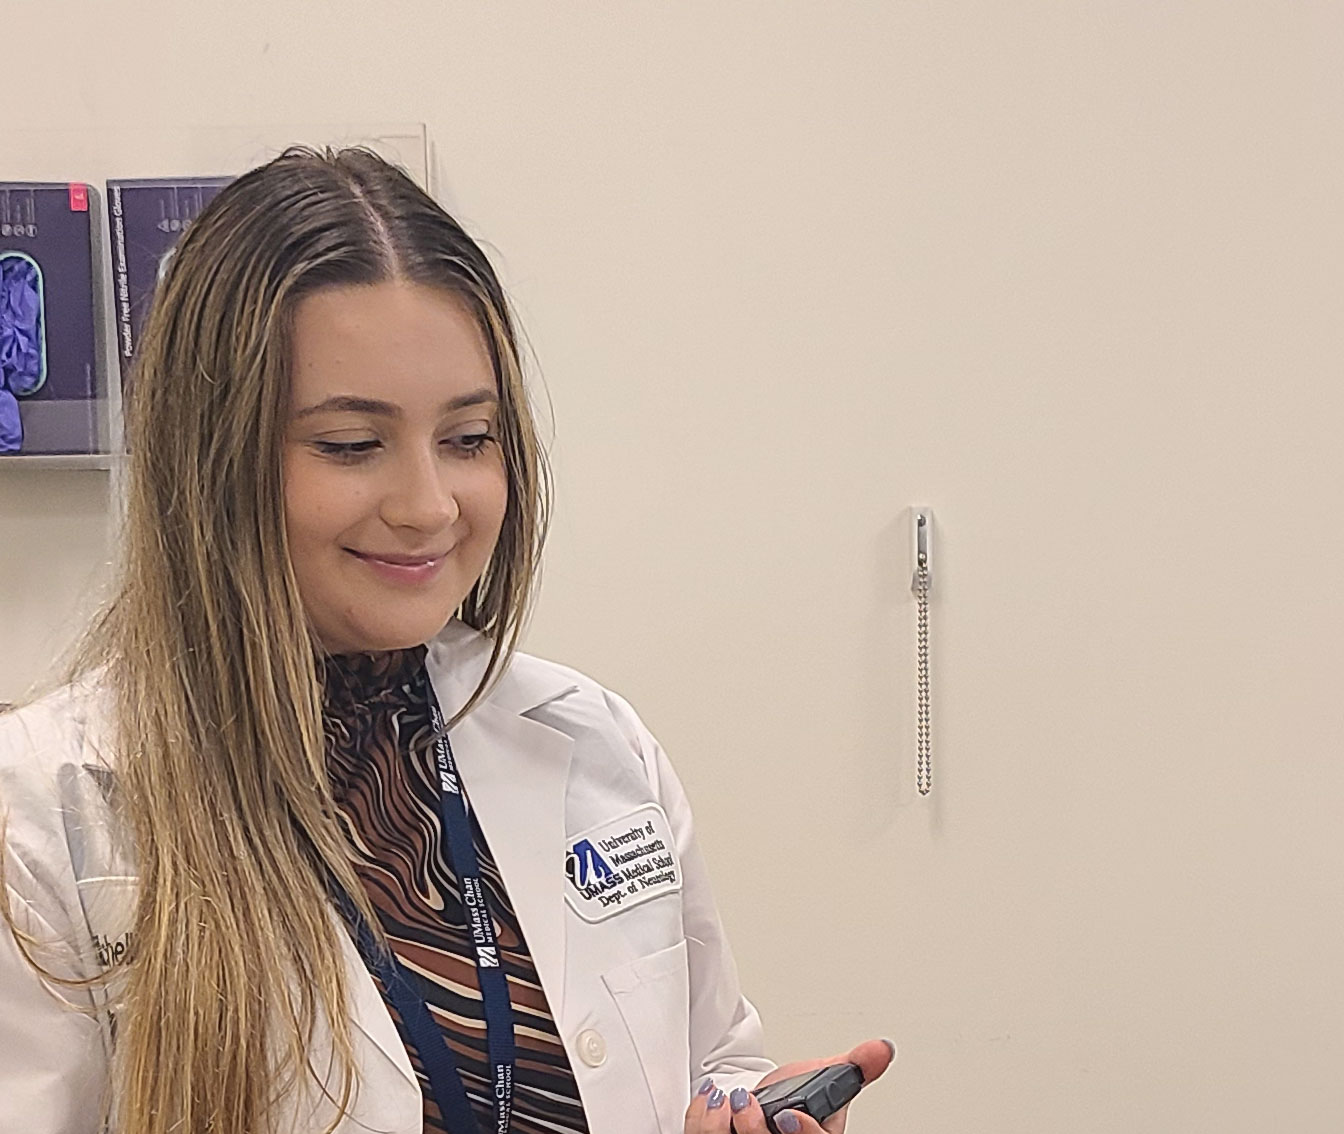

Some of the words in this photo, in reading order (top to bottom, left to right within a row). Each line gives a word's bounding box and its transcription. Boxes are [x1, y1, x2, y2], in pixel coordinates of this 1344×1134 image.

[113, 186, 123, 217] Gloves
[116, 217, 127, 273] Examination
[118, 273, 129, 301] Nitrile
[121, 302, 131, 321] Free
[123, 323, 133, 357] Powder
[598, 829, 646, 851] University
[646, 820, 656, 835] of
[623, 859, 654, 883] Medical
[464, 878, 476, 906] Chan
[473, 878, 485, 907] SCHOOL
[580, 873, 625, 900] UMASS
[598, 890, 628, 908] Dept.
[628, 882, 638, 895] of
[471, 908, 485, 943] UMass
[480, 910, 493, 943] MEDICAL
[495, 1065, 505, 1098] Chan
